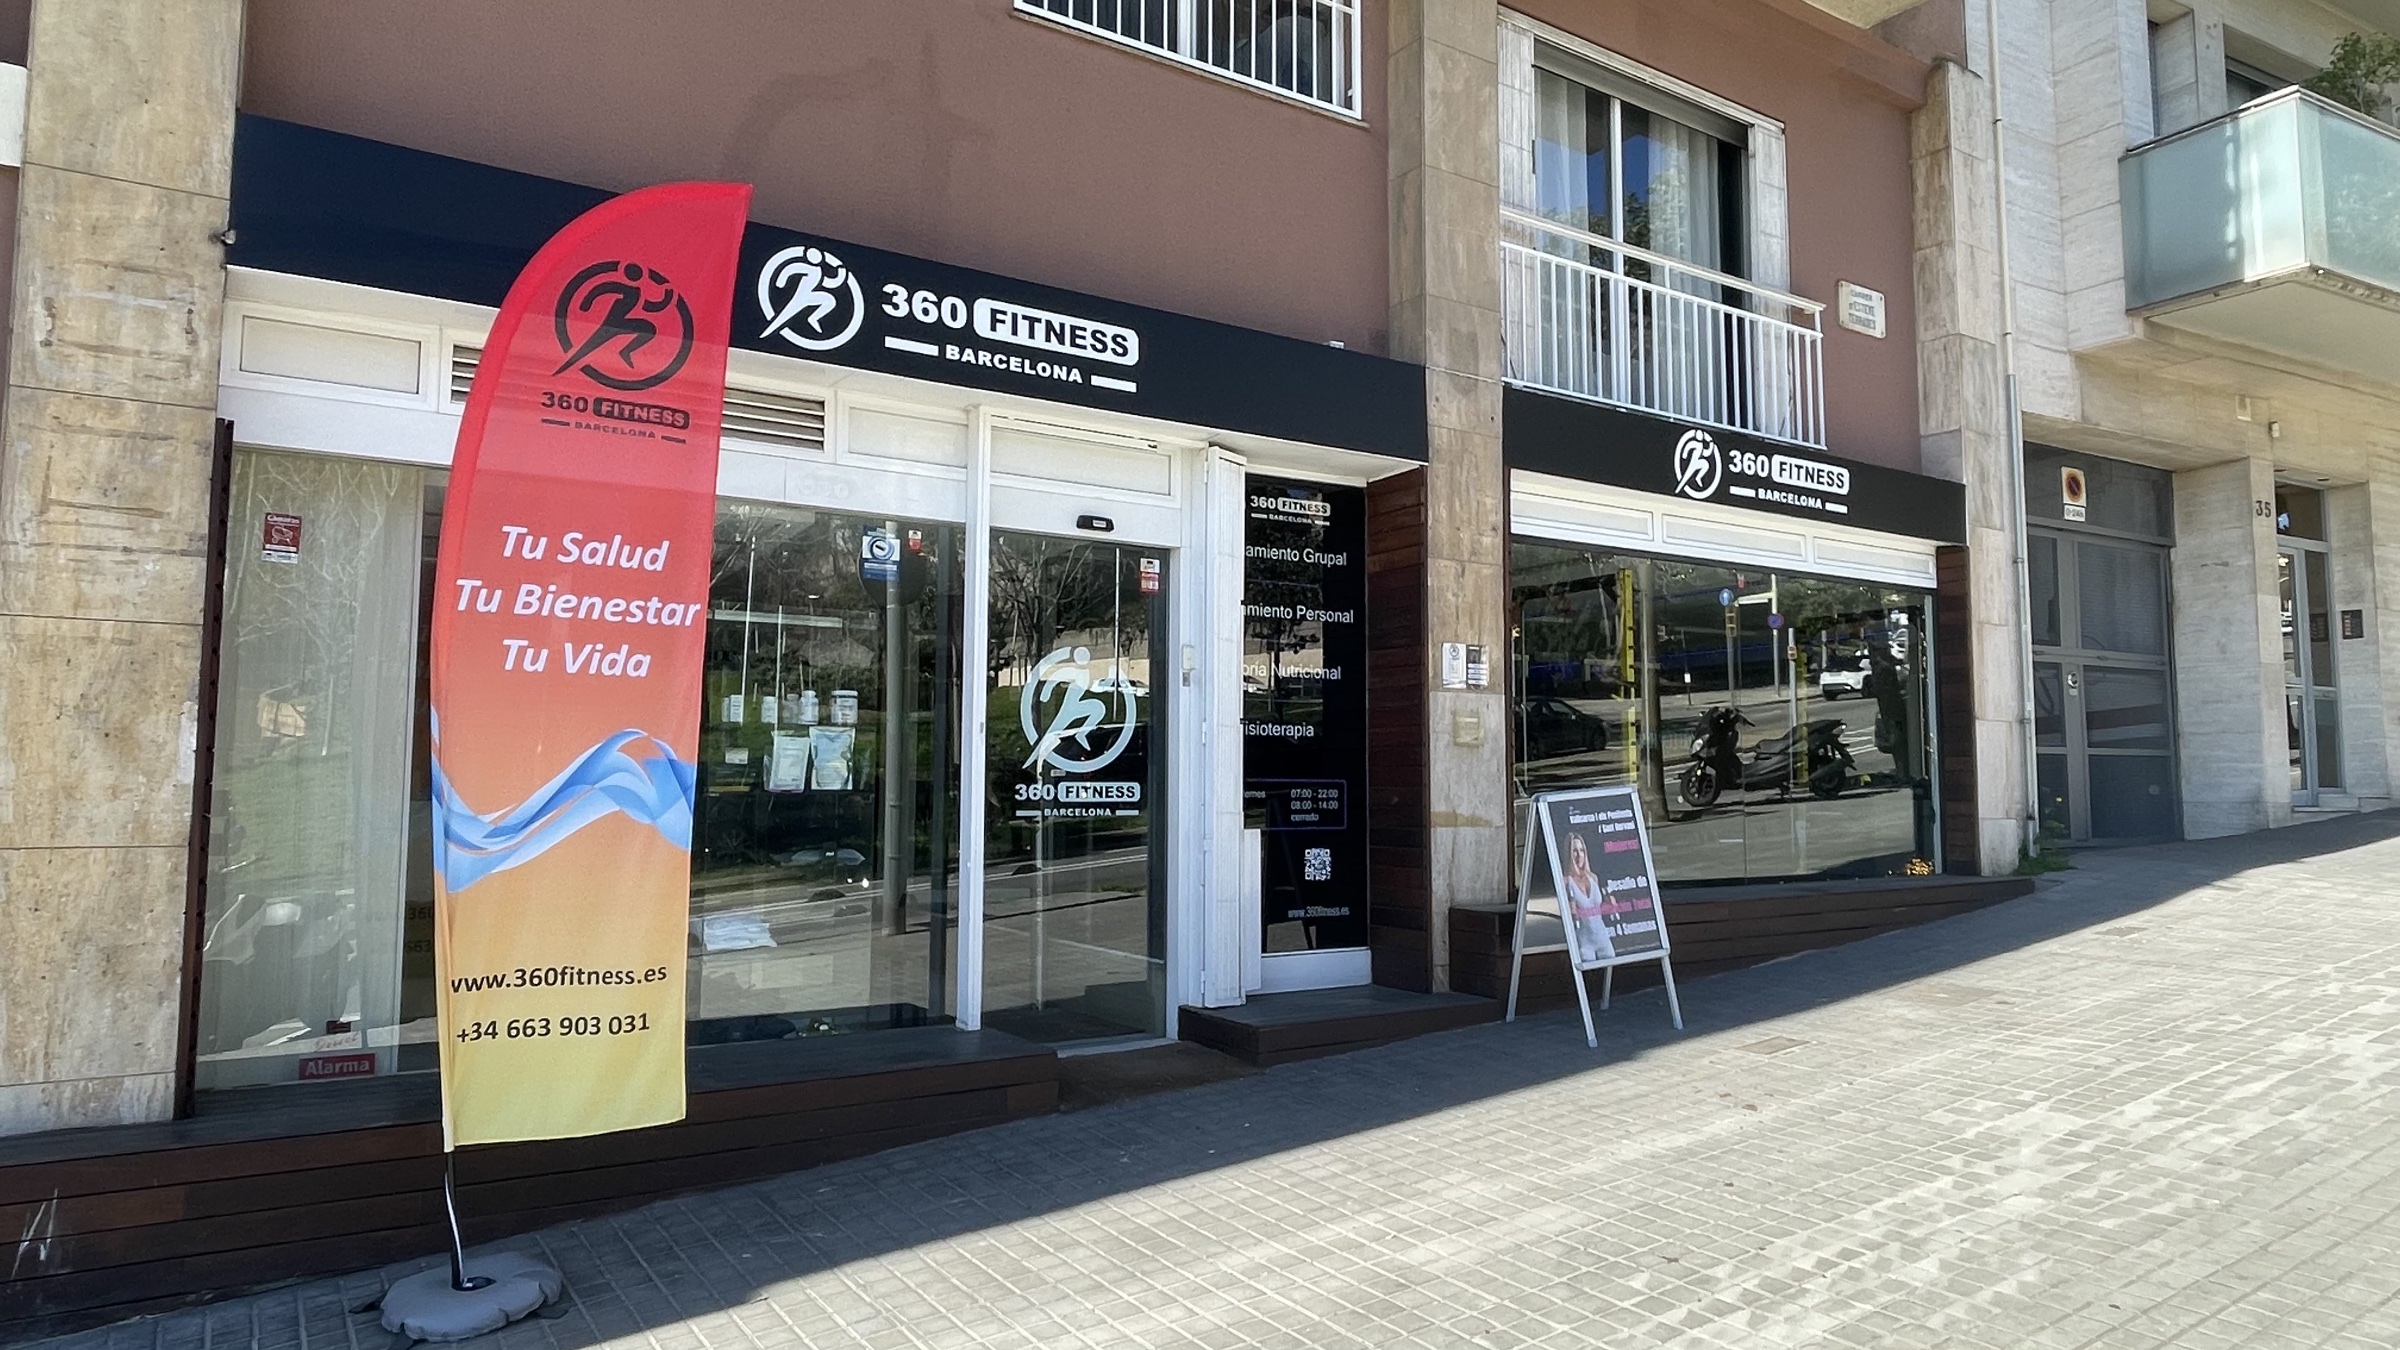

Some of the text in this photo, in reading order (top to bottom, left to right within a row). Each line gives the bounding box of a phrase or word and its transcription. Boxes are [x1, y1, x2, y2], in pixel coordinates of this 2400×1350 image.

[881, 283, 1130, 358] 360 FITNESS
[945, 344, 1083, 384] BARCELONA
[541, 391, 686, 427] 360 FITNESS
[574, 421, 656, 438] BARCELONA
[1728, 450, 1845, 489] 360 FITNESS
[1250, 495, 1328, 514] 360 FITNESS
[1757, 488, 1823, 509] BARCELONA
[1269, 513, 1312, 524] BARCELONA
[2255, 500, 2272, 518] 35
[501, 525, 670, 572] Tu Salud
[1302, 548, 1347, 567] Grupal
[456, 579, 701, 627] Tu Bienestar
[1296, 605, 1354, 623] Personal
[502, 639, 652, 678] Tu Vida
[1272, 662, 1342, 680] Nutricional
[1014, 783, 1136, 800] 360 FITNESS
[1290, 789, 1312, 798] 07:00
[1317, 789, 1339, 798] 22:00
[1043, 808, 1112, 817] BARCELONA
[456, 1013, 651, 1043] +34 663 903 031
[305, 1059, 370, 1076] Alarma
